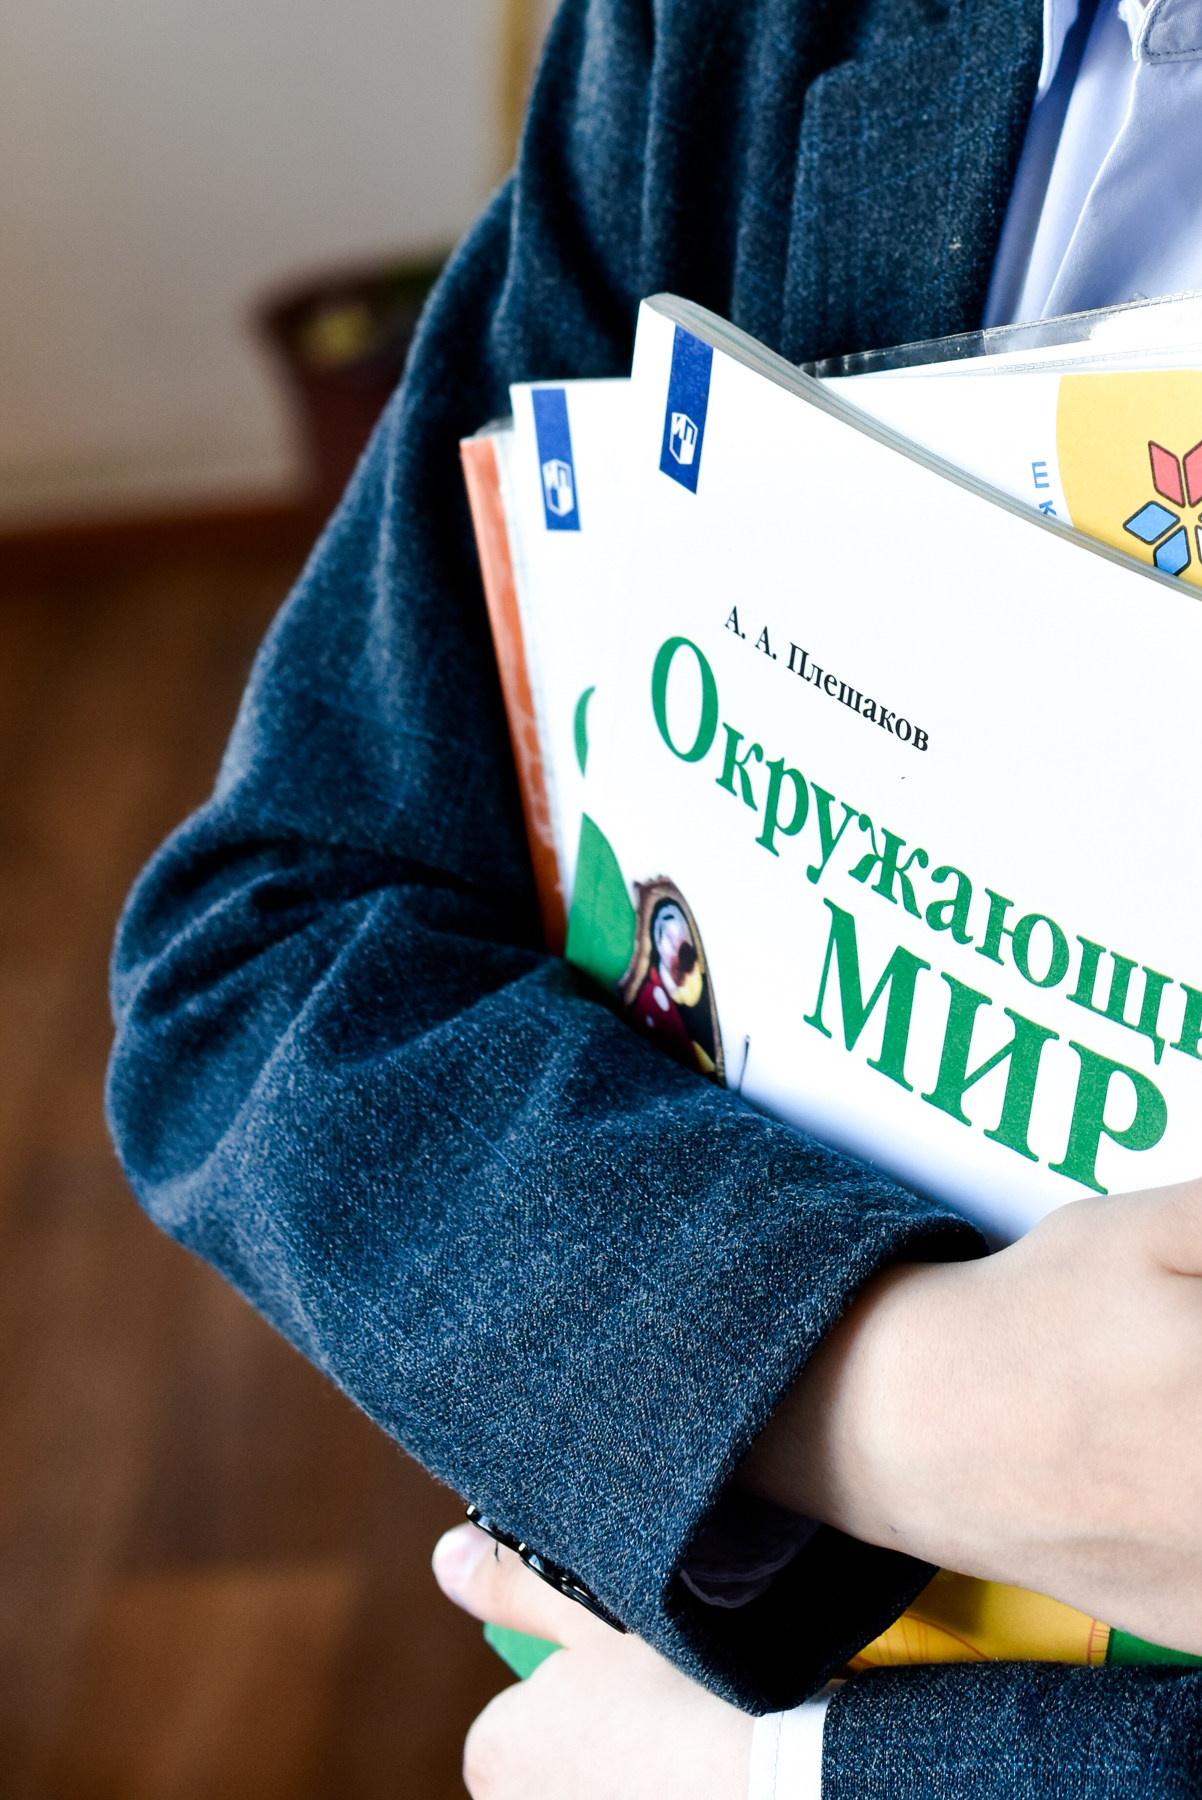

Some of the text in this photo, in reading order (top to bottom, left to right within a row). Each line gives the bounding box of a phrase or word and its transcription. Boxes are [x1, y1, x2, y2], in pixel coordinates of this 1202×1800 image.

[724, 605, 929, 752] А. А. Плешаков
[803, 897, 1168, 1195] МИР
